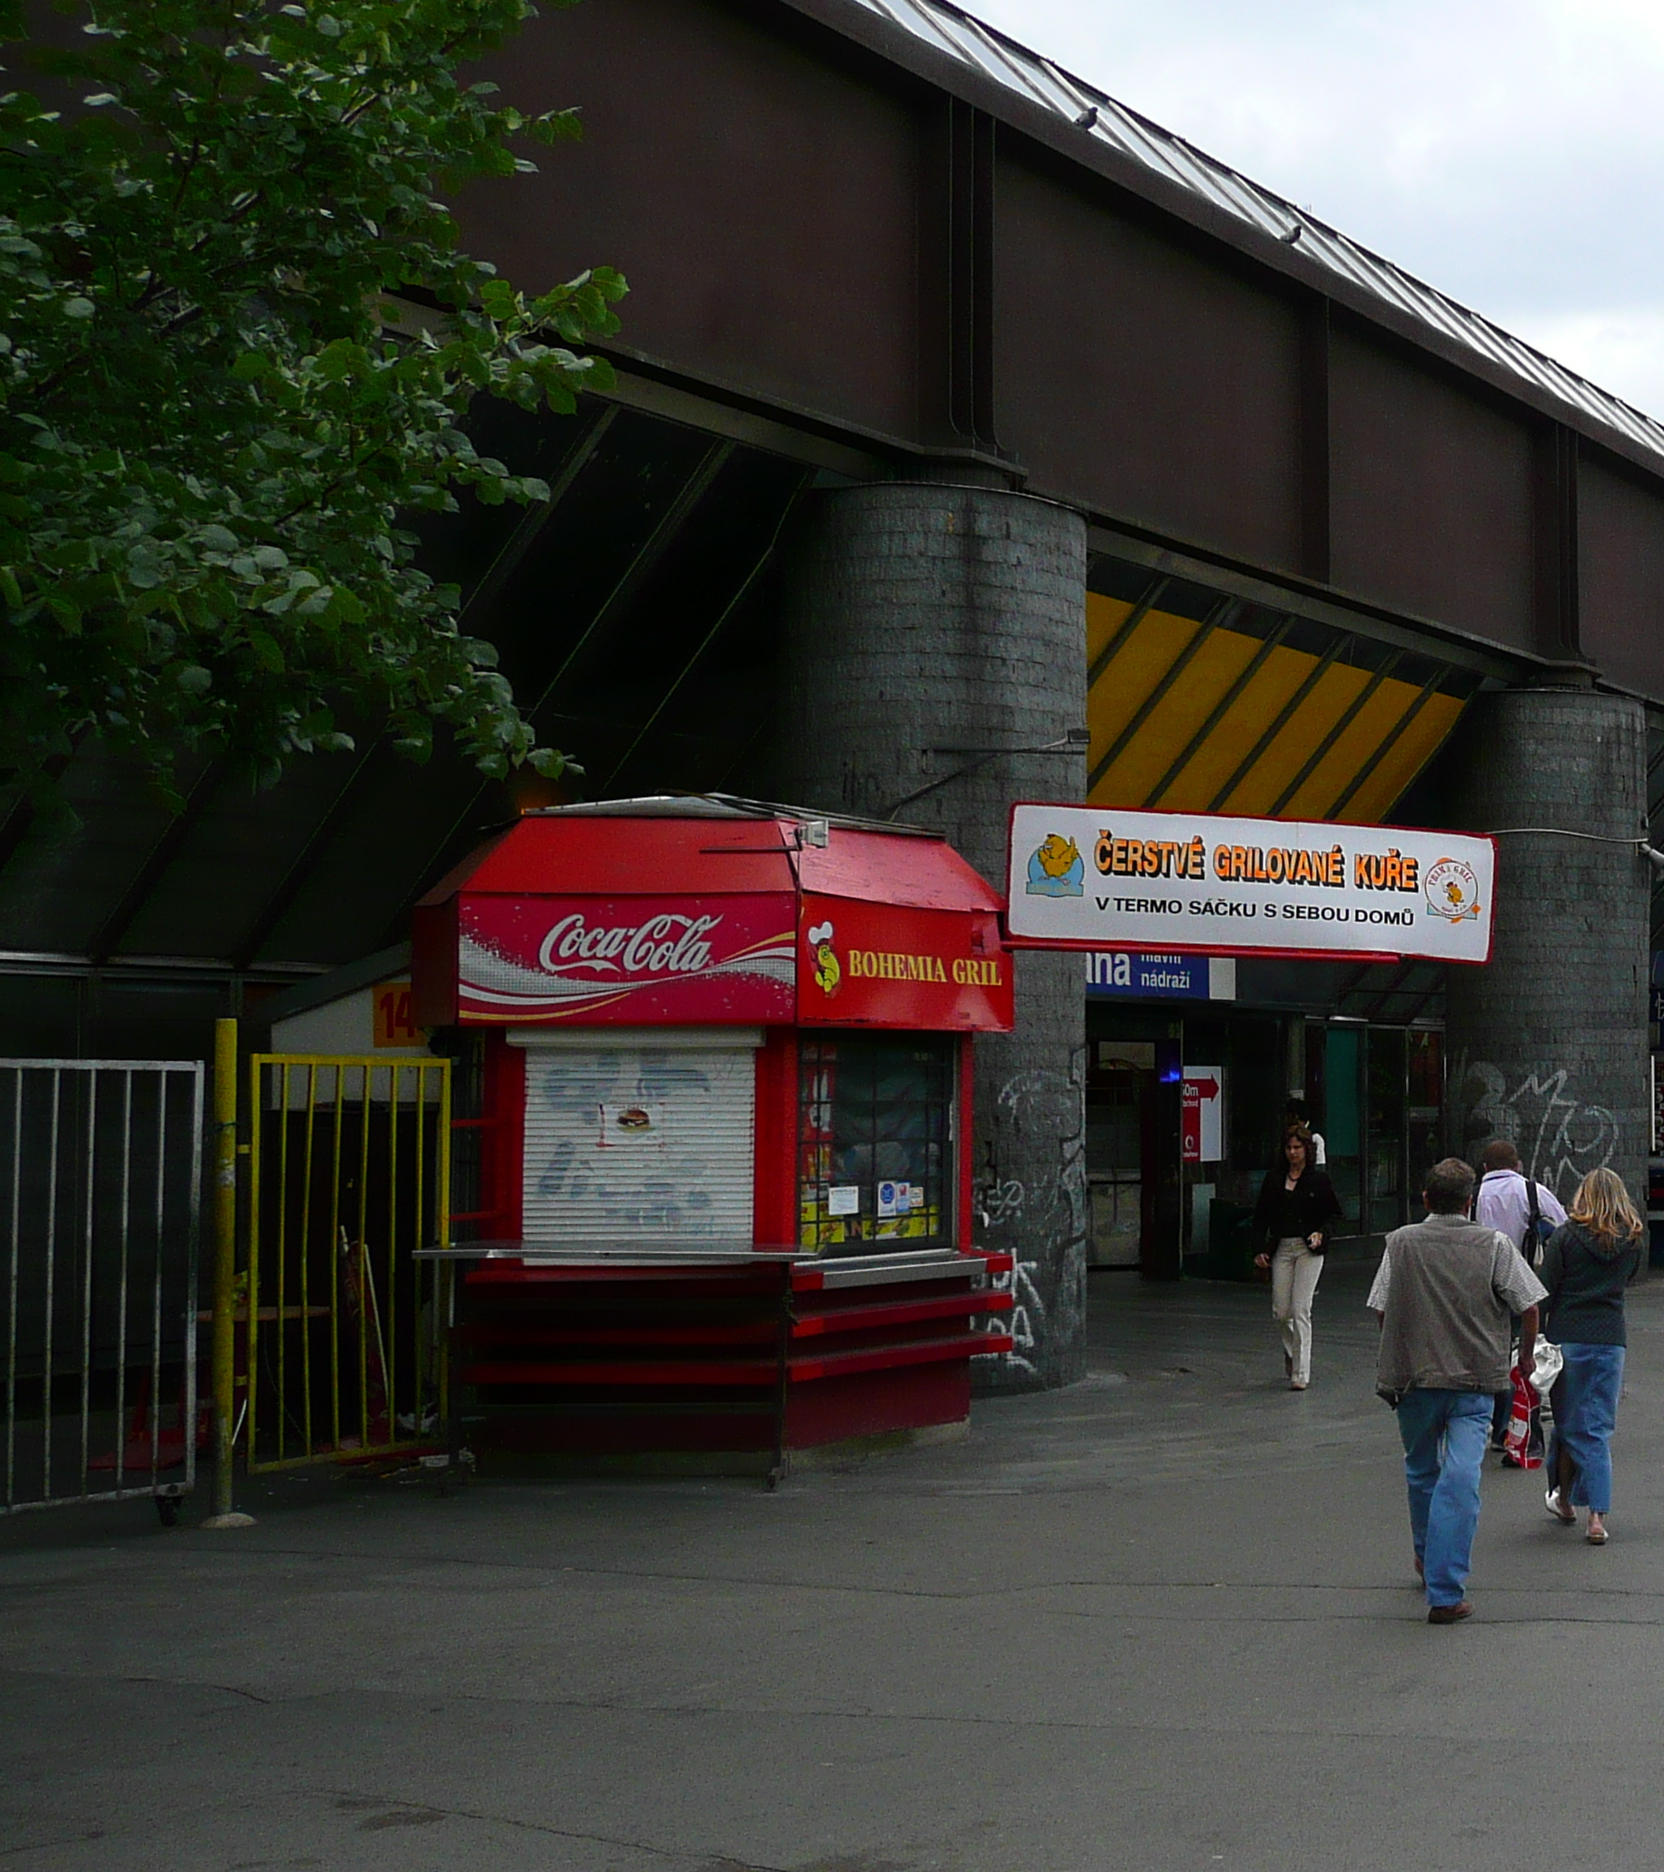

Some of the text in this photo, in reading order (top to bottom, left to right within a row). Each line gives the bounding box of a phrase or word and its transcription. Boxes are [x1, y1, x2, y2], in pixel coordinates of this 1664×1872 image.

[1094, 830, 1420, 893] ČERSTVÉ GRILOVANÉ KUŘE
[1095, 894, 1415, 927] V TERMO SÁČKU S SEBOU DOMŮ
[538, 913, 724, 973] Coca-Cola
[847, 948, 1003, 987] BOHEMIA GRIL
[1140, 969, 1192, 989] nádraží
